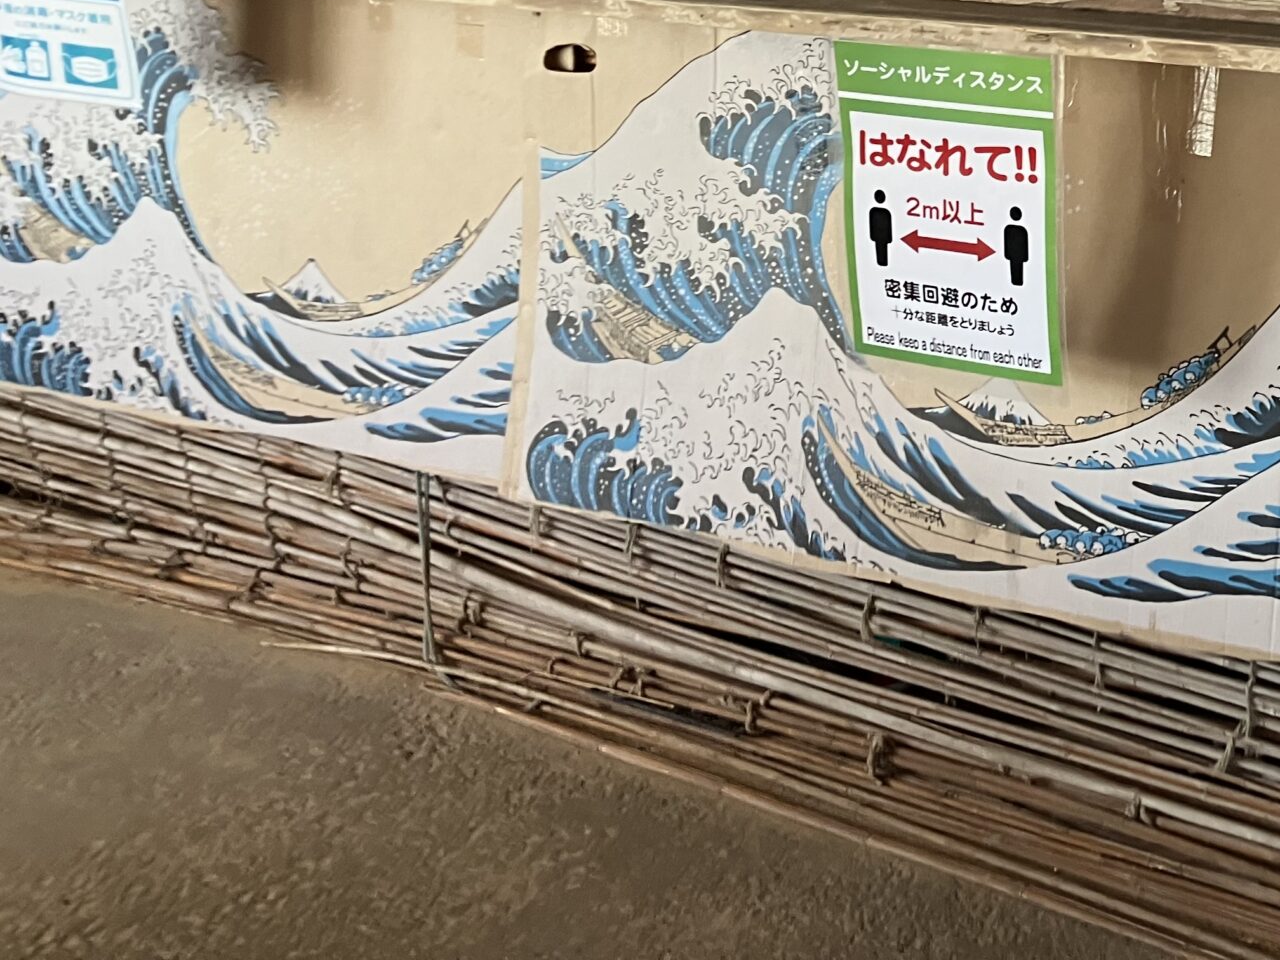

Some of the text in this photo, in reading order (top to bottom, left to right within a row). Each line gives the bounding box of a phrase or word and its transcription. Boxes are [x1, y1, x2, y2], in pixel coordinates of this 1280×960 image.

[843, 58, 1044, 95] ソーシャルディスタンス
[858, 129, 1039, 185] はなれて!!
[905, 196, 985, 227] 2m以上
[884, 278, 1019, 316] 密集回避のため
[891, 305, 1015, 338] 十分な距離をとりましょう
[866, 326, 1043, 369] Please keep a distance from each other
